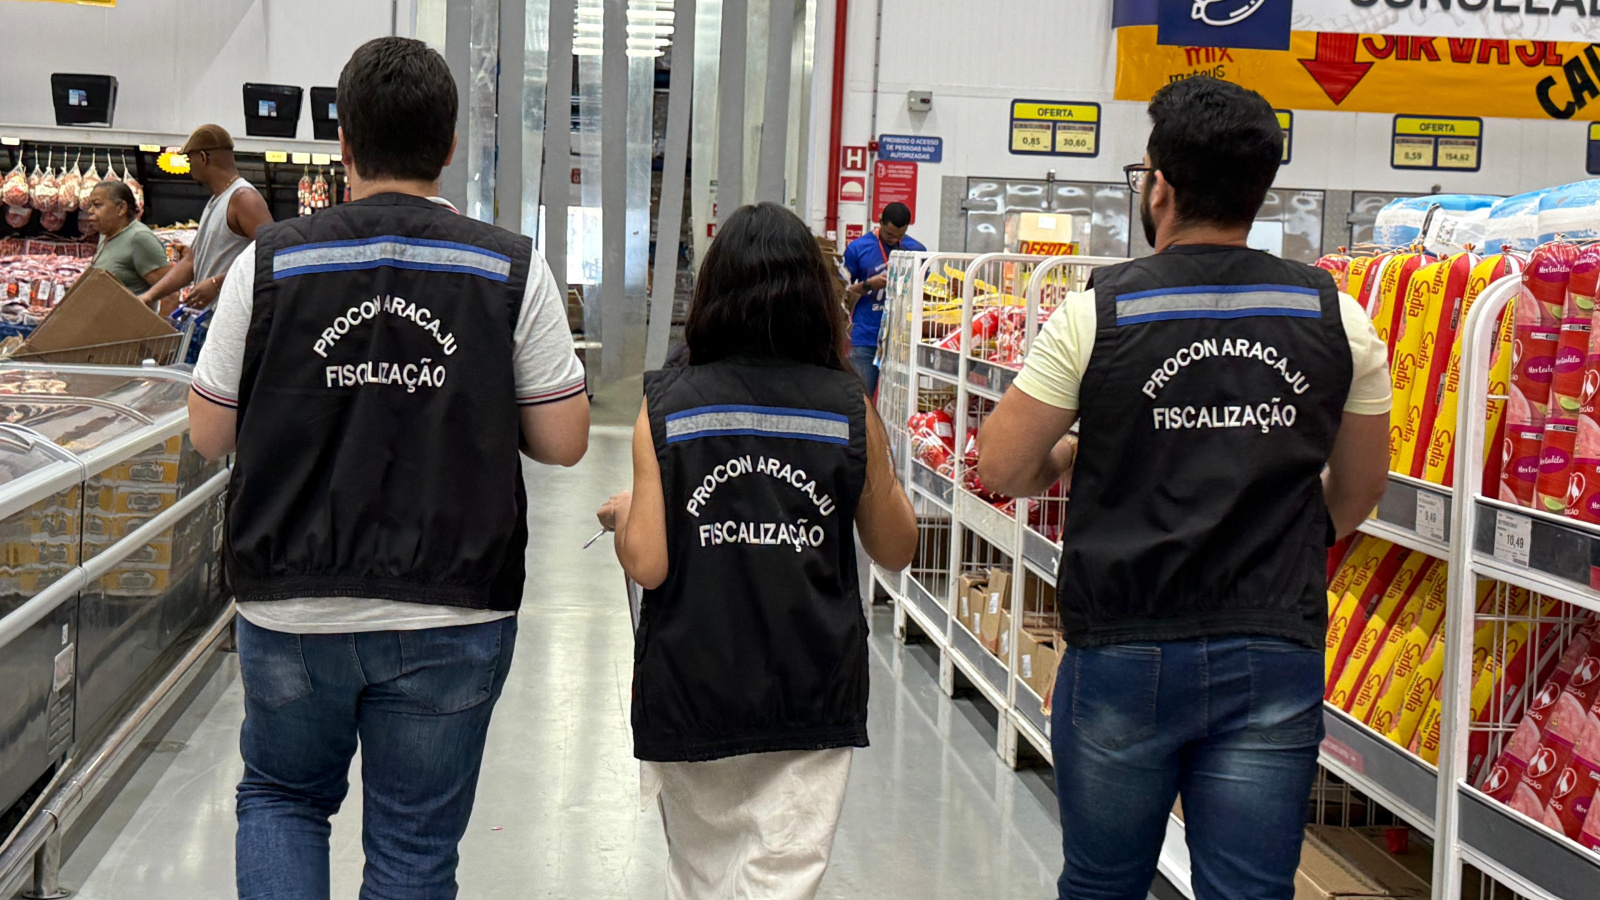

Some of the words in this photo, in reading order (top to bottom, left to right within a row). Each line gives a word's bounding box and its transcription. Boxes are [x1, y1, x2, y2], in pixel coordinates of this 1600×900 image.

[1037, 107, 1074, 118] OFERTA
[1419, 122, 1456, 132] OFERTA
[882, 136, 909, 144] PROIBIDO
[895, 144, 921, 152] PESSOAS
[1022, 136, 1040, 146] 0,85
[1063, 138, 1086, 148] 30,60
[847, 150, 860, 168] H
[1408, 280, 1430, 318] Sadia
[313, 294, 381, 358] PROCON
[383, 294, 458, 356] ARACAJU
[326, 357, 446, 393] FISCLIZAÇÃO
[1141, 338, 1218, 399] PROCON
[1221, 338, 1310, 395] ARACAJU
[1394, 353, 1416, 390] Sadia
[1152, 396, 1297, 433] FISCALIZAÇÃO
[1429, 430, 1451, 468] Sadia
[686, 454, 753, 518] PROCON
[756, 455, 836, 516] ARACAJU
[699, 518, 825, 553] FISCALIZAÇÃO
[1506, 534, 1524, 549] 10,49
[1331, 564, 1357, 594] Sadia
[1353, 556, 1380, 587] Sadia
[1386, 569, 1414, 599] Sadia
[1326, 616, 1348, 649] Sadia
[1352, 628, 1379, 660] Sadia
[1389, 612, 1416, 644] Sadia
[1395, 643, 1422, 678] Sadia
[1356, 673, 1382, 707] Sadia
[1405, 676, 1434, 712] Sadia
